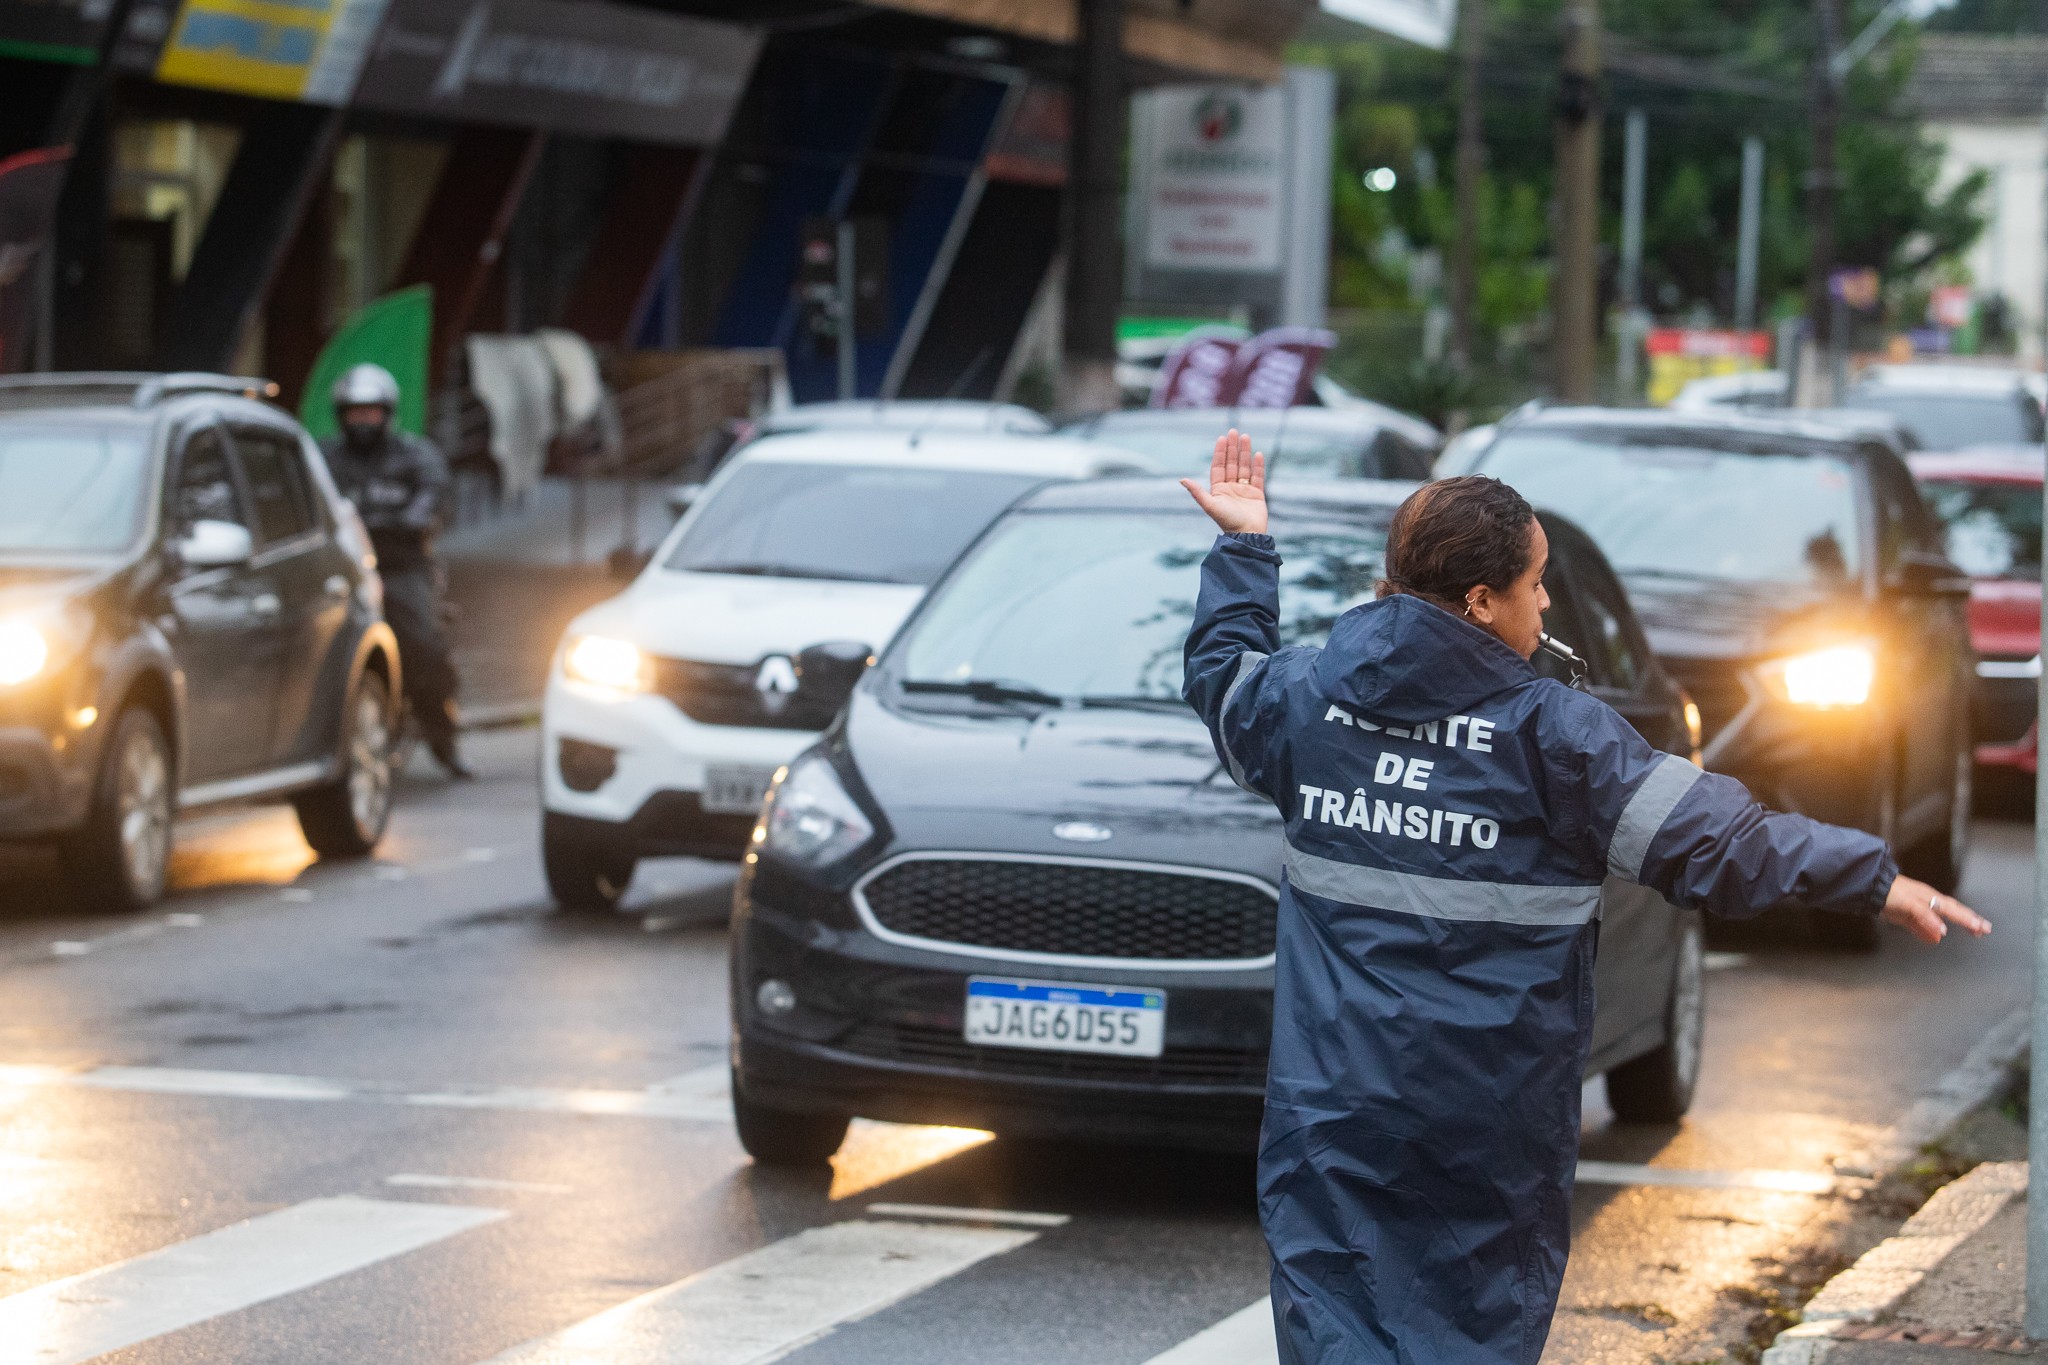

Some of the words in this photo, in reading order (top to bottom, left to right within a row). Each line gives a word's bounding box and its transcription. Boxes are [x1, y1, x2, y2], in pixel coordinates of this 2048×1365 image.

[1324, 704, 1497, 753] ANTE
[1373, 751, 1435, 791] DE
[1299, 784, 1500, 850] TRÂNSITO
[983, 1001, 1141, 1046] JAG6D55
